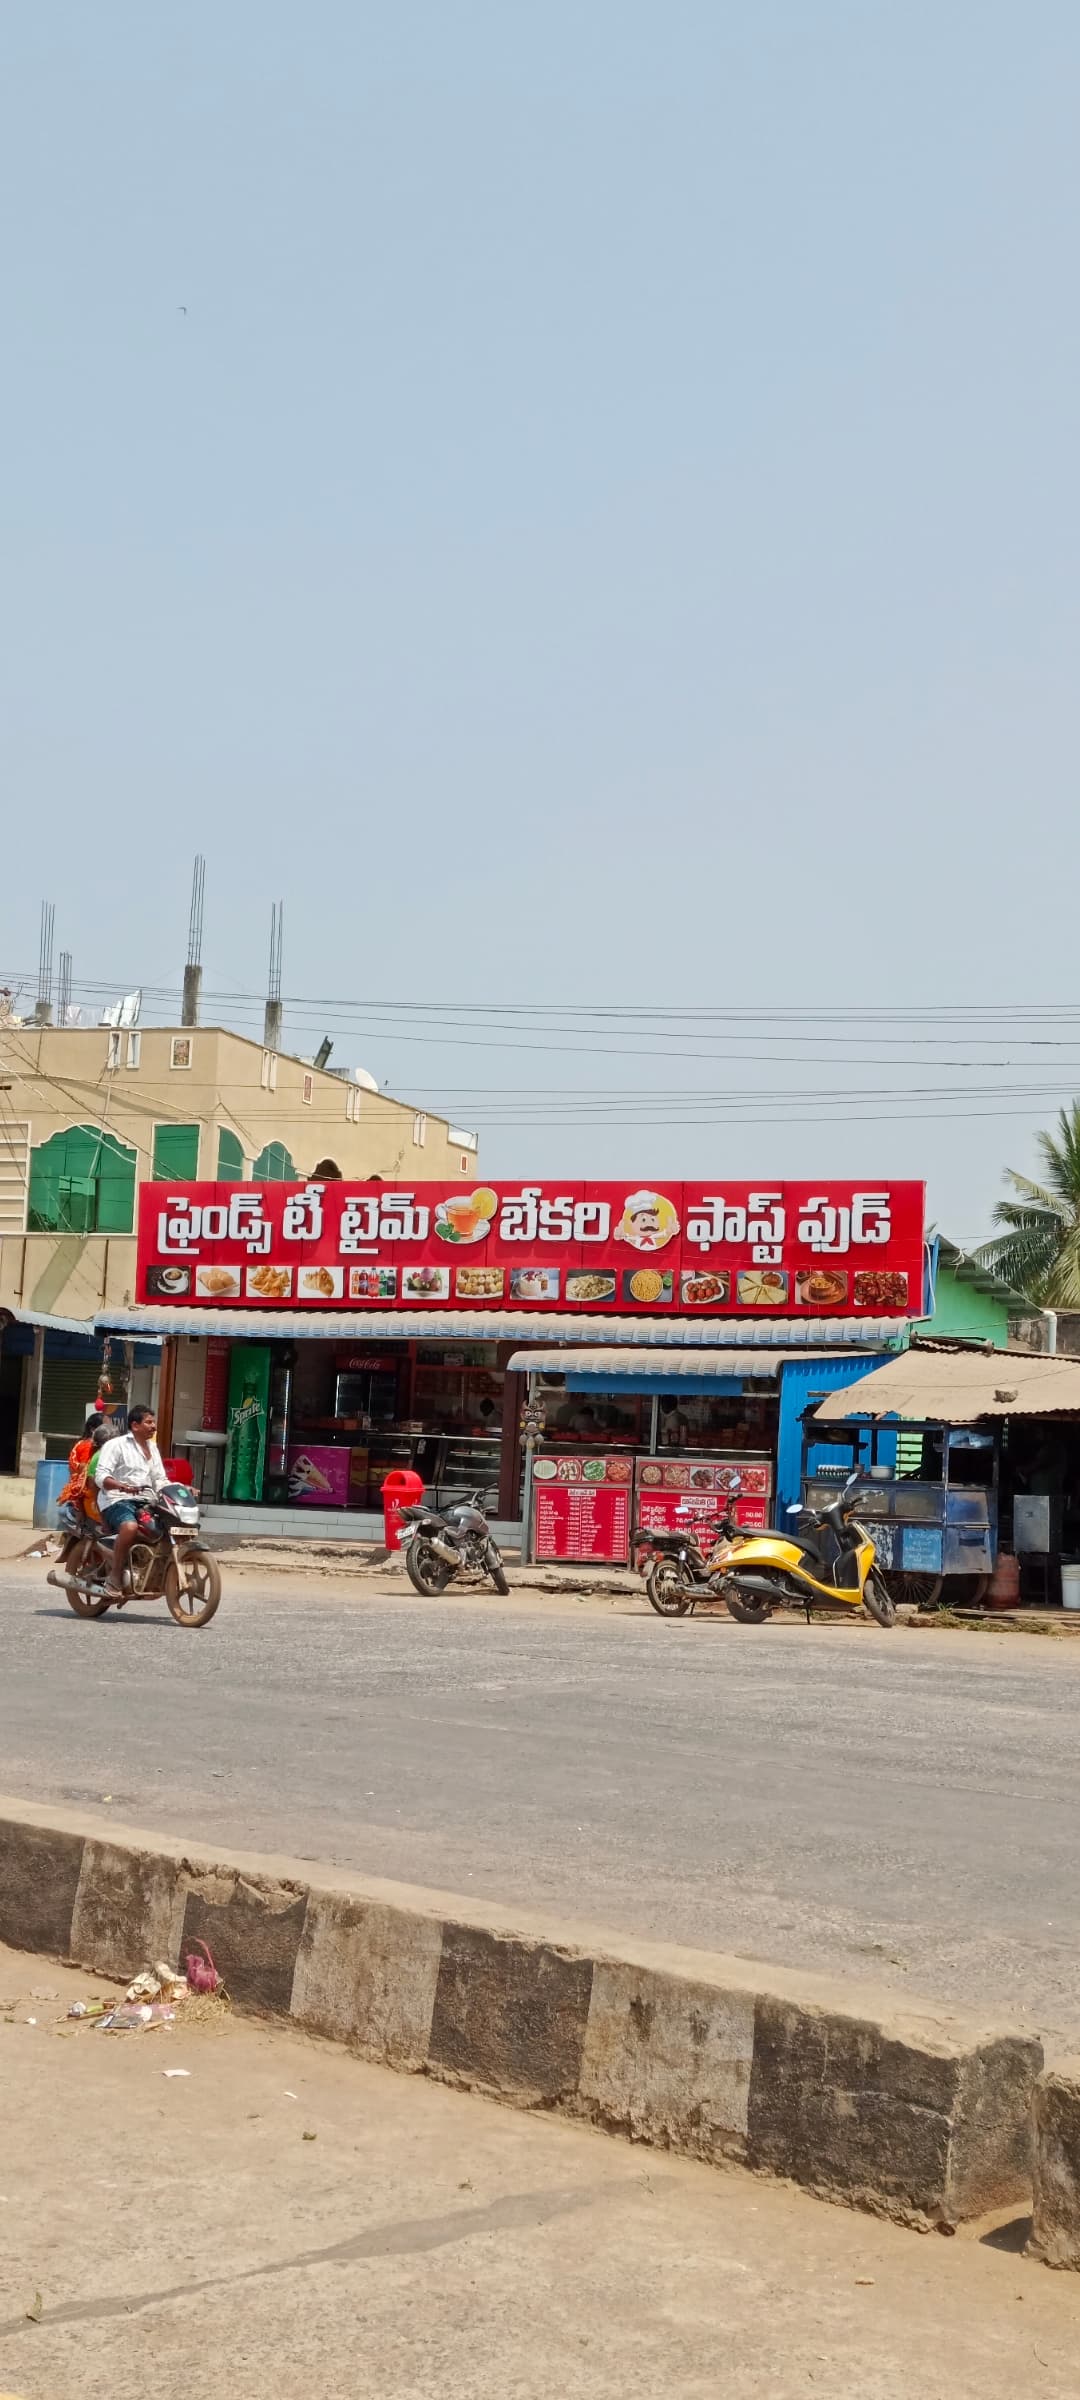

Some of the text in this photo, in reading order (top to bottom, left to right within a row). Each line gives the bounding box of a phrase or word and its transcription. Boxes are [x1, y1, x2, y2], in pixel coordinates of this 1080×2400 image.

[157, 1184, 891, 1264] ఫ్రెండ్స్ టీ టైమ్ బేకరి ఫాస్ట్ ఫుడ్
[233, 1402, 261, 1425] Sprite
